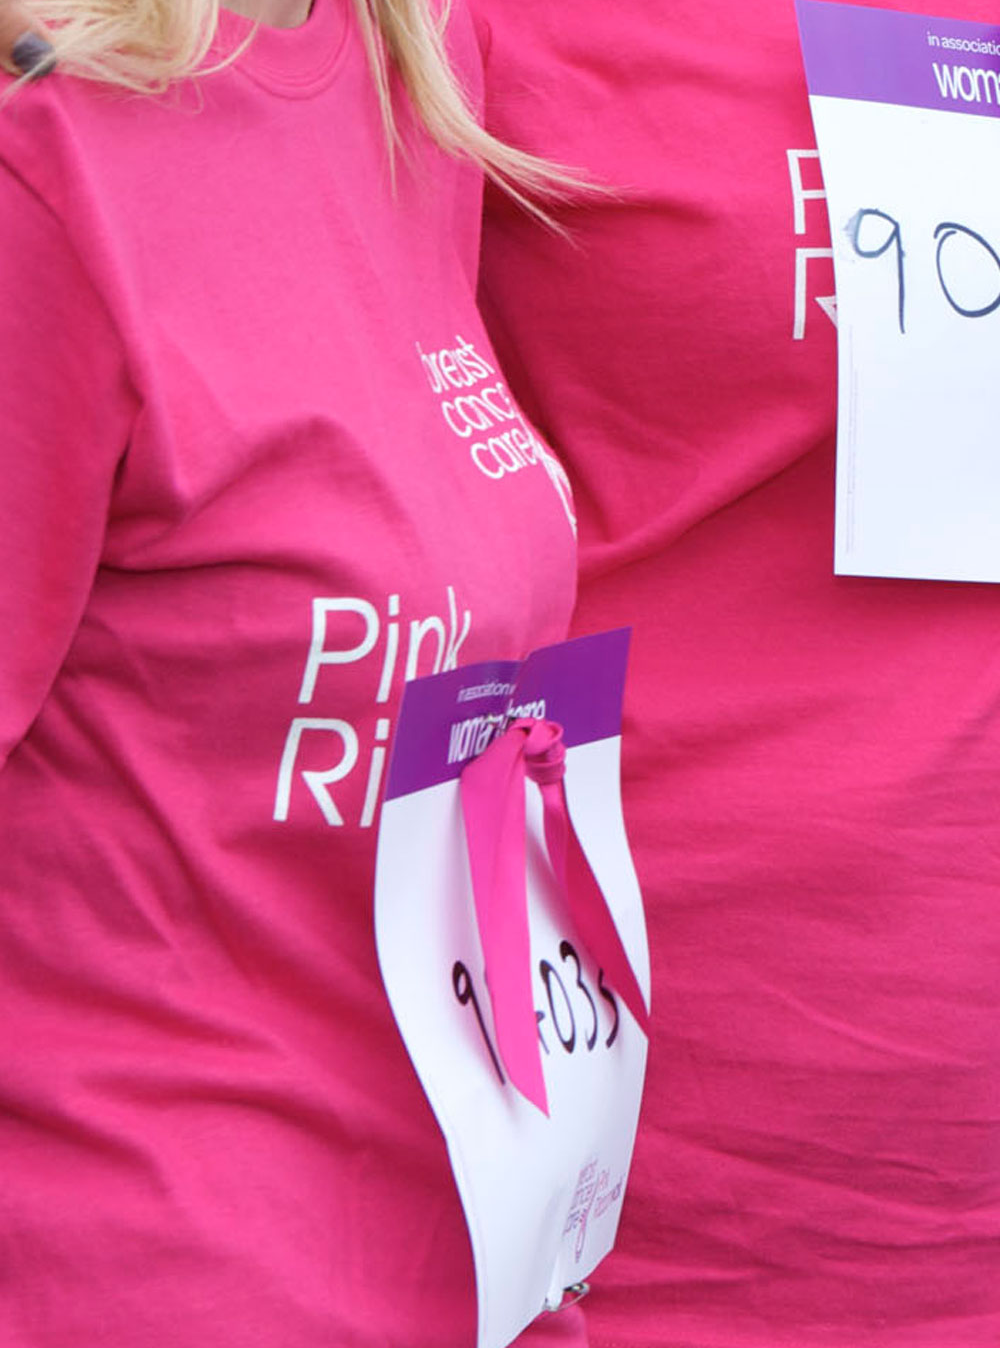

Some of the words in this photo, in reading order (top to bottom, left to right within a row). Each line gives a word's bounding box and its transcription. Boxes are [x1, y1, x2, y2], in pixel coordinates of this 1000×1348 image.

[927, 31, 941, 47] in
[441, 382, 517, 439] canc
[470, 428, 538, 479] care
[298, 586, 472, 704] Pink
[452, 940, 620, 1086] 9033
